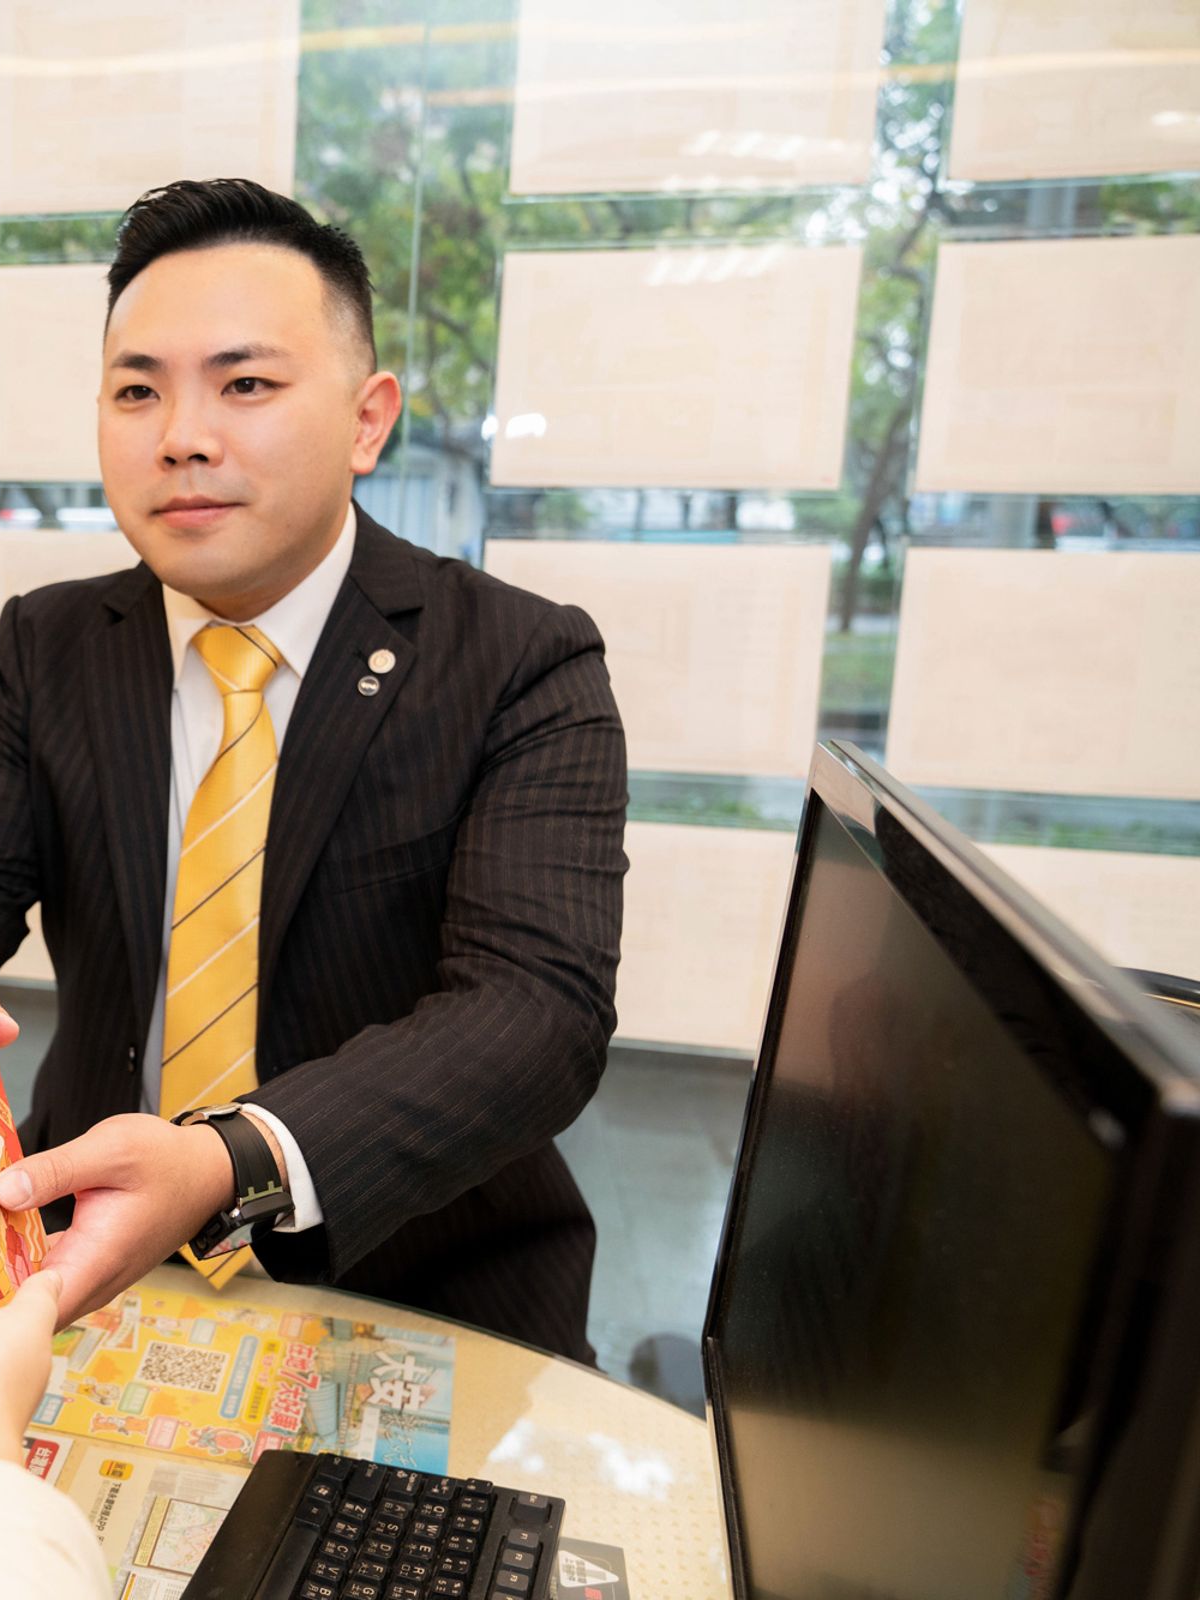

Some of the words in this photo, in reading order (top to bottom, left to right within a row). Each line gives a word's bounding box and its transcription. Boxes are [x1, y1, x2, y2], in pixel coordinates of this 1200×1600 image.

[270, 1343, 320, 1431] 在地7大好康
[367, 1350, 429, 1409] 大安
